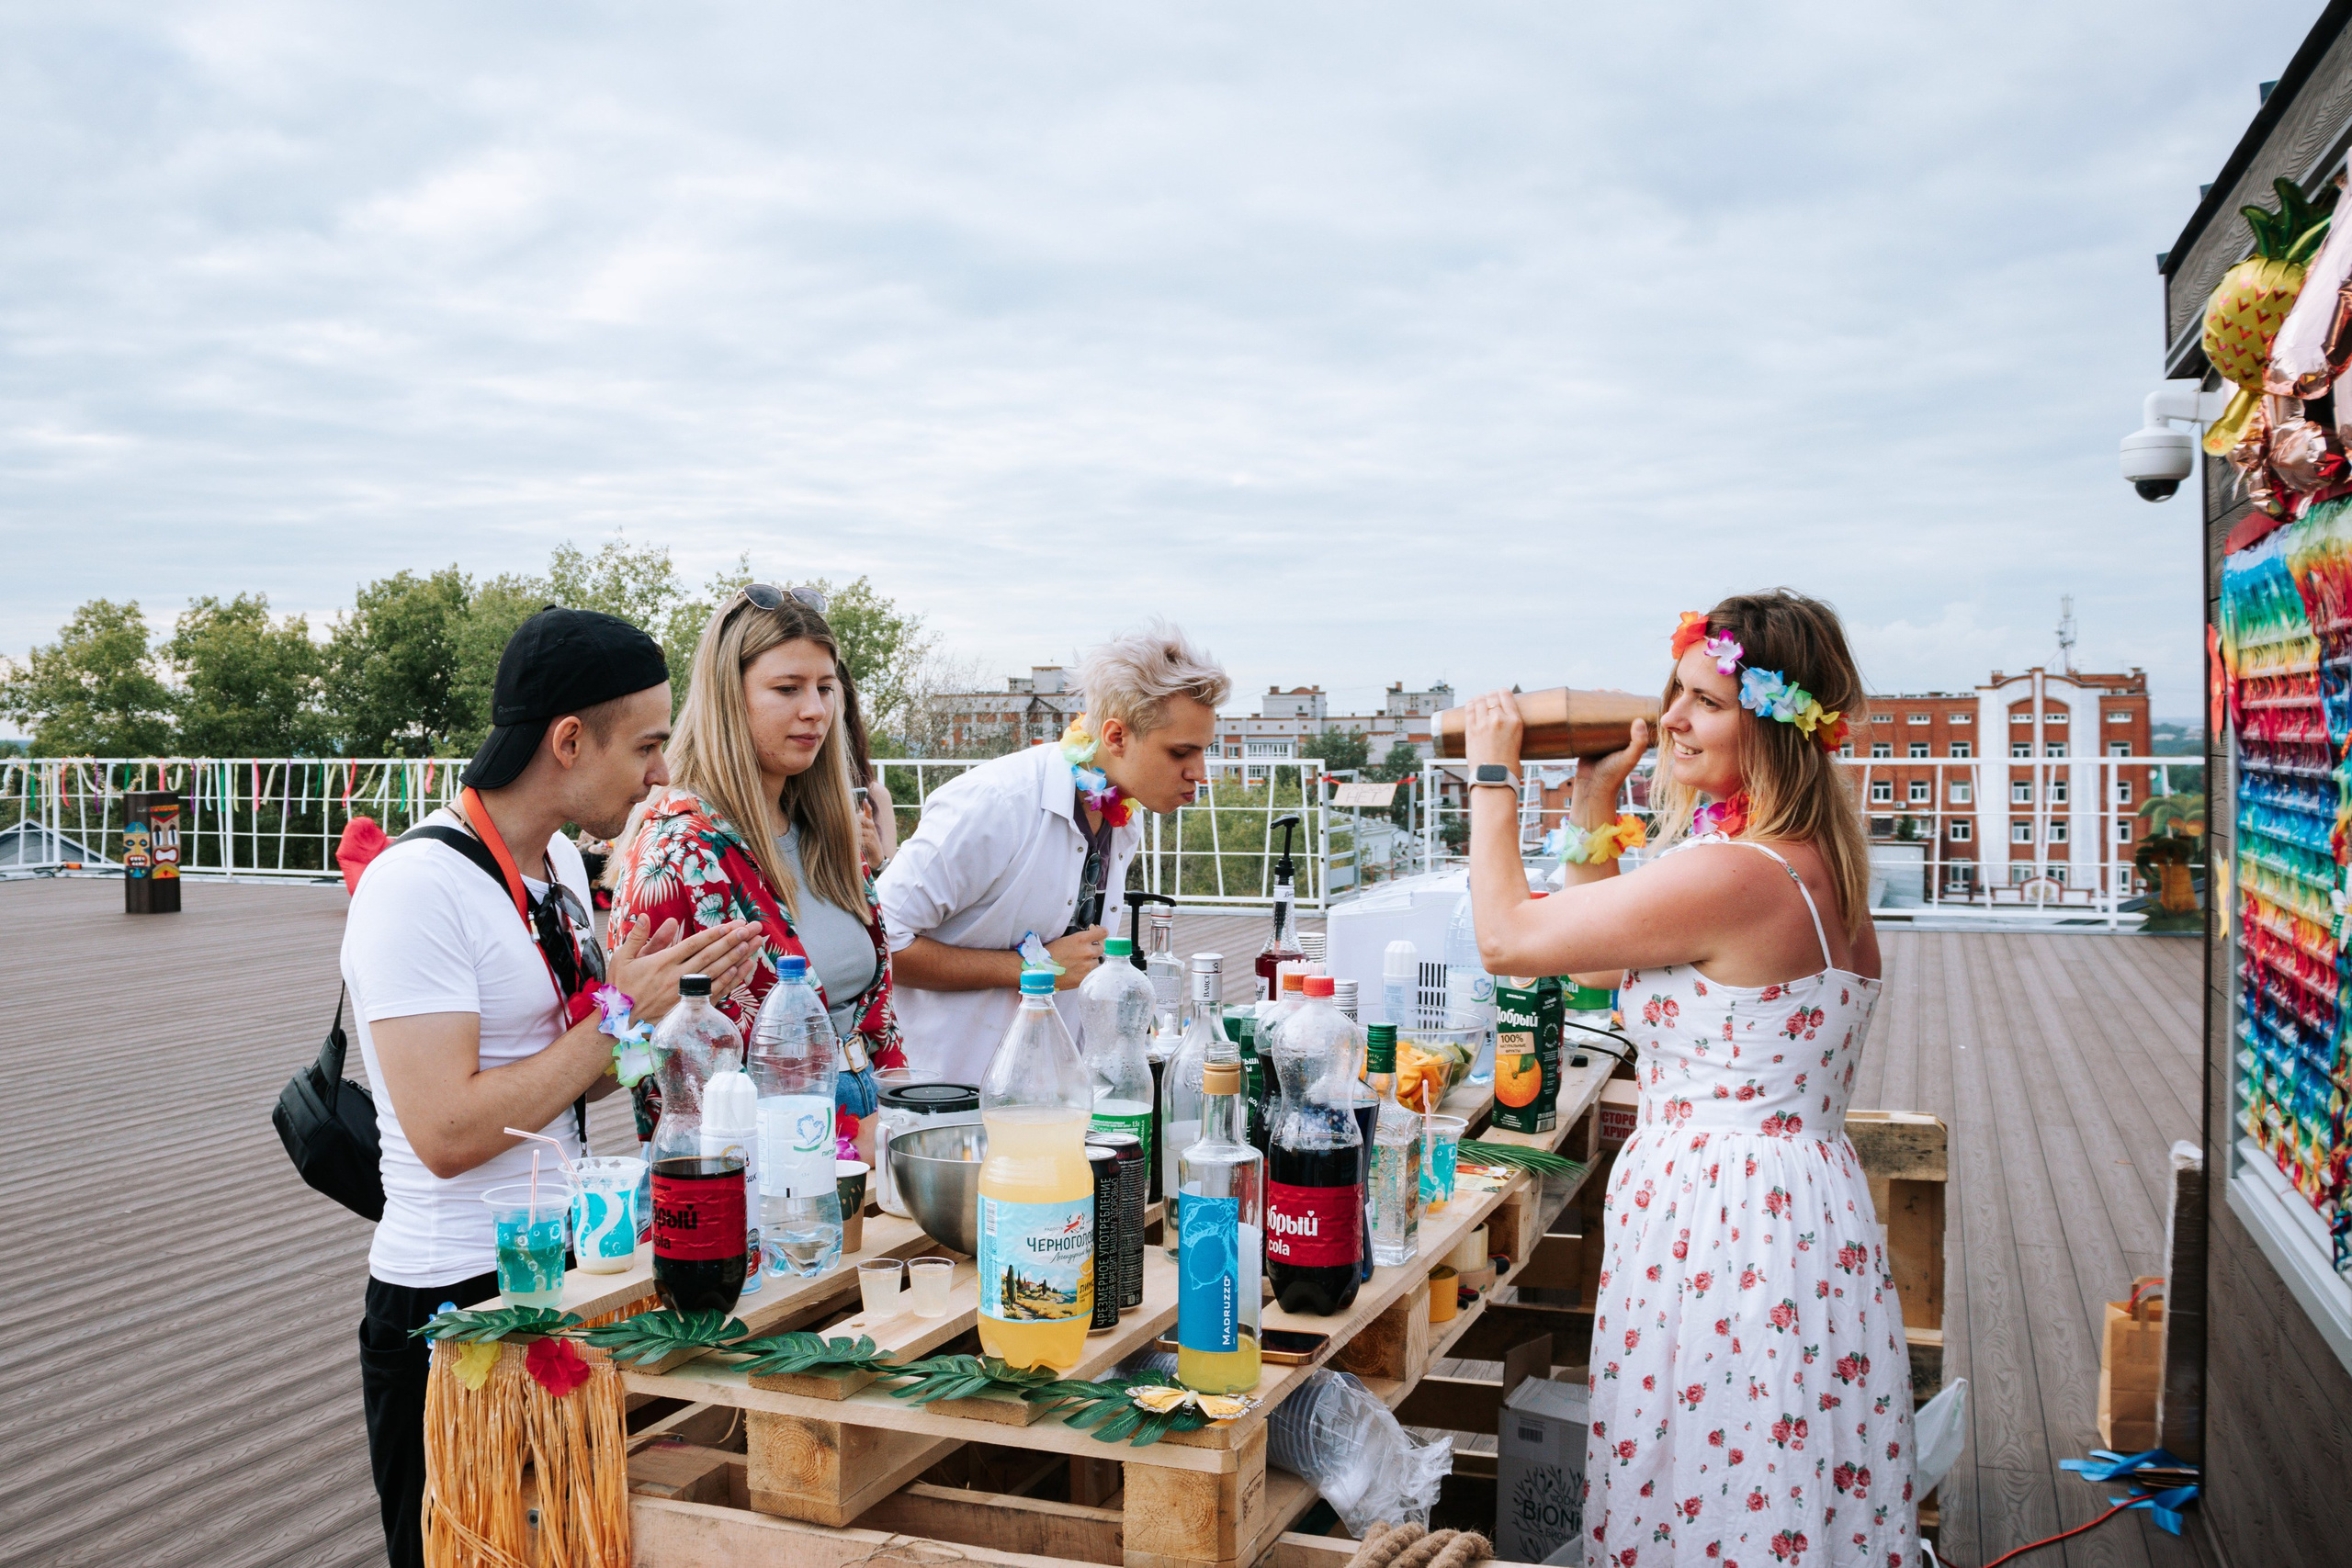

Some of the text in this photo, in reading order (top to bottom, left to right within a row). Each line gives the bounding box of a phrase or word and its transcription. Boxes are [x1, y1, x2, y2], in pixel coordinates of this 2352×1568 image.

[1346, 791, 1380, 803] НЕТ
[1500, 1033, 1524, 1043] 100%
[1110, 1177, 1119, 1220] ЗДОРОВЬЮ
[1267, 1205, 1318, 1236] брый
[1097, 1177, 1111, 1325] ЧРЕЗМЕРНОЕ УПОТРЕБЛЕНИЕ
[1110, 1221, 1118, 1254] ВАШЕМУ
[1268, 1239, 1290, 1256] cola
[1108, 1255, 1117, 1284] ВРЕДИТ
[1108, 1285, 1117, 1323] АЛКОГОЛЯ
